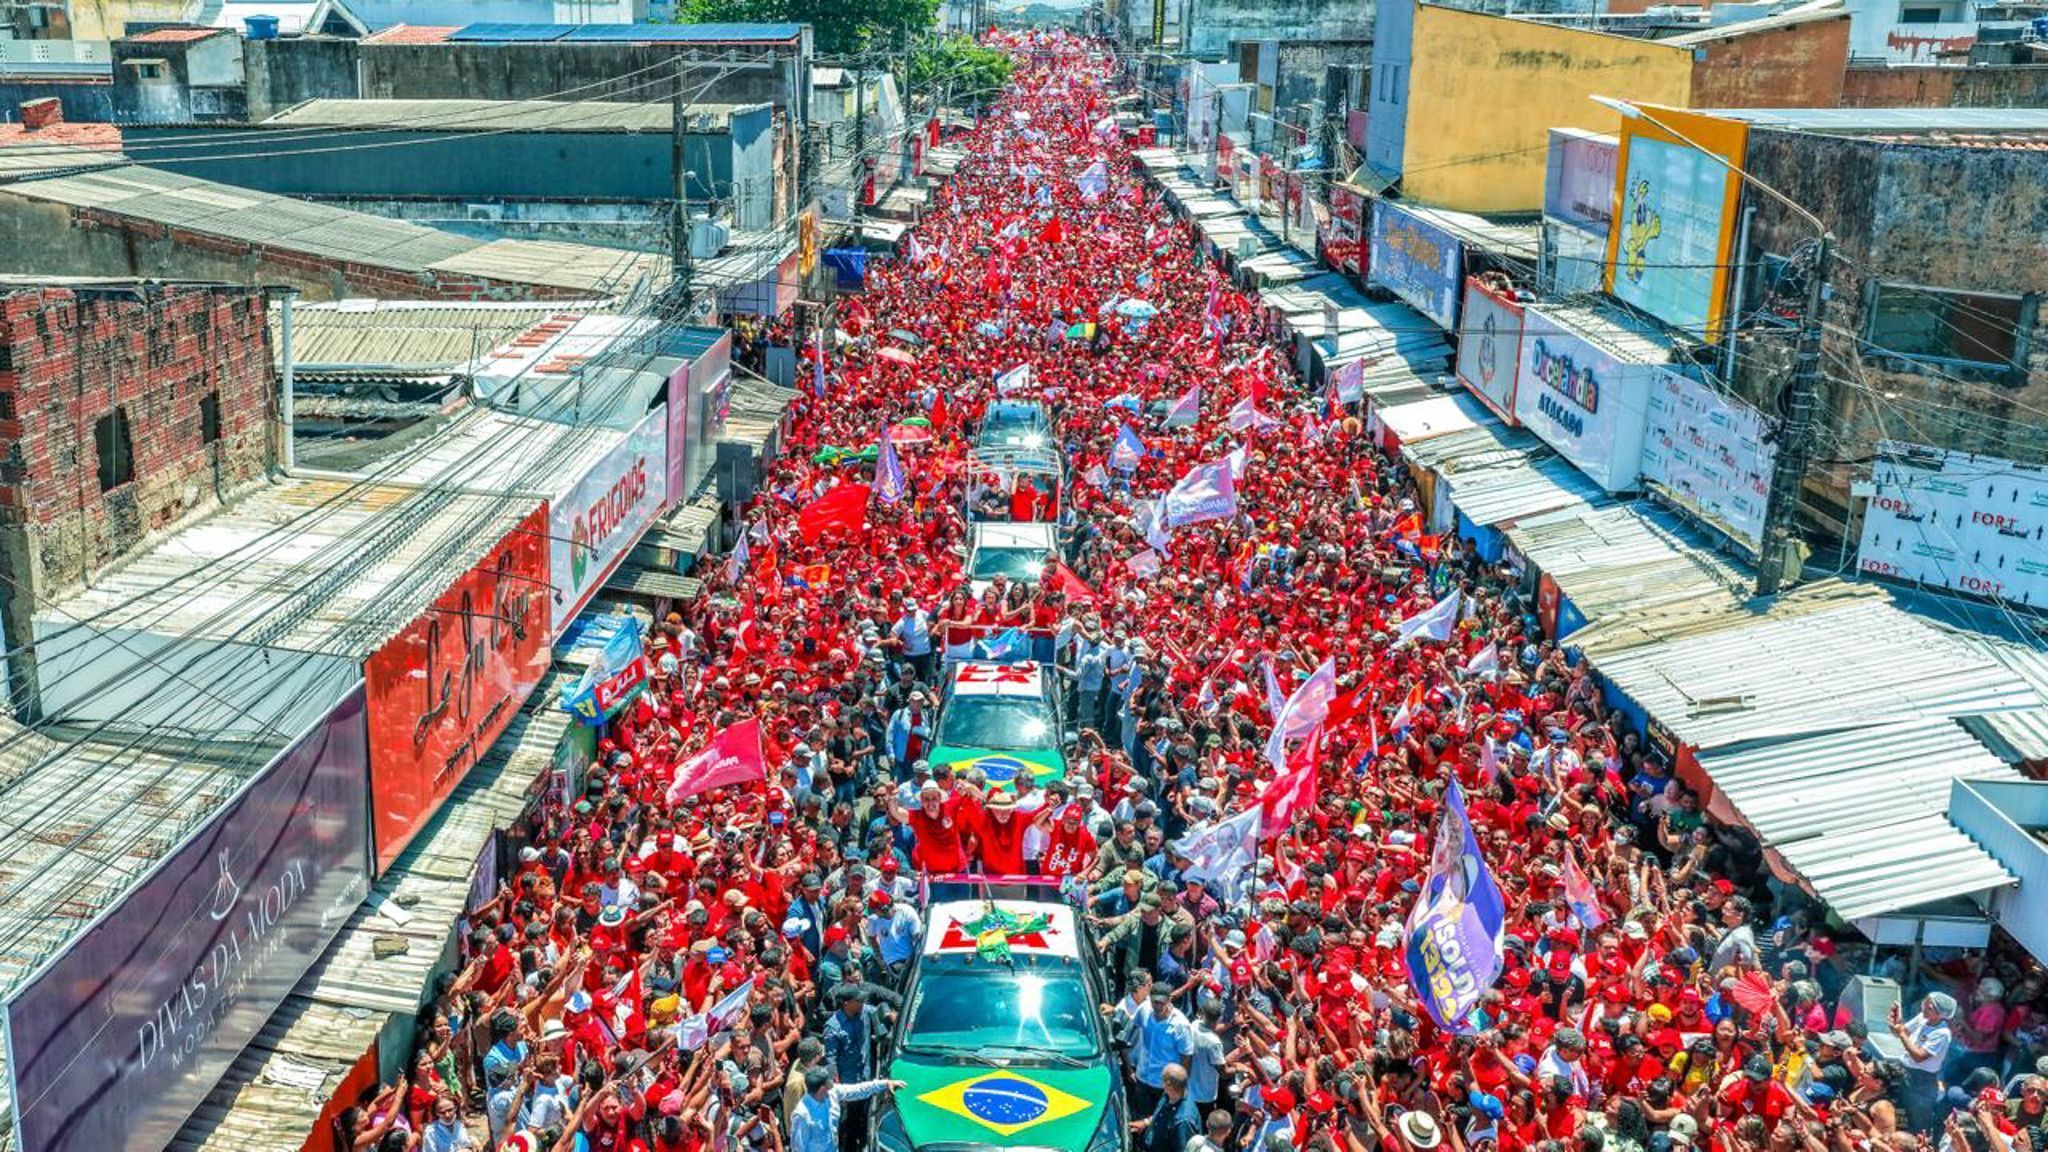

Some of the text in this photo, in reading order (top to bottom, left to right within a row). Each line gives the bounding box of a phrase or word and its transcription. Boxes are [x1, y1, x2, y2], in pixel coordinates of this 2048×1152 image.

[1537, 393, 1583, 438] ATACADO
[588, 456, 646, 548] FRIGOIÁS
[1872, 495, 1913, 514] FORT
[1972, 511, 2019, 530] FORT
[1861, 558, 1903, 575] FORT
[1960, 575, 2005, 595] FORT
[139, 859, 306, 1070] DIVAS DA MODA
[171, 1011, 216, 1069] MODA
